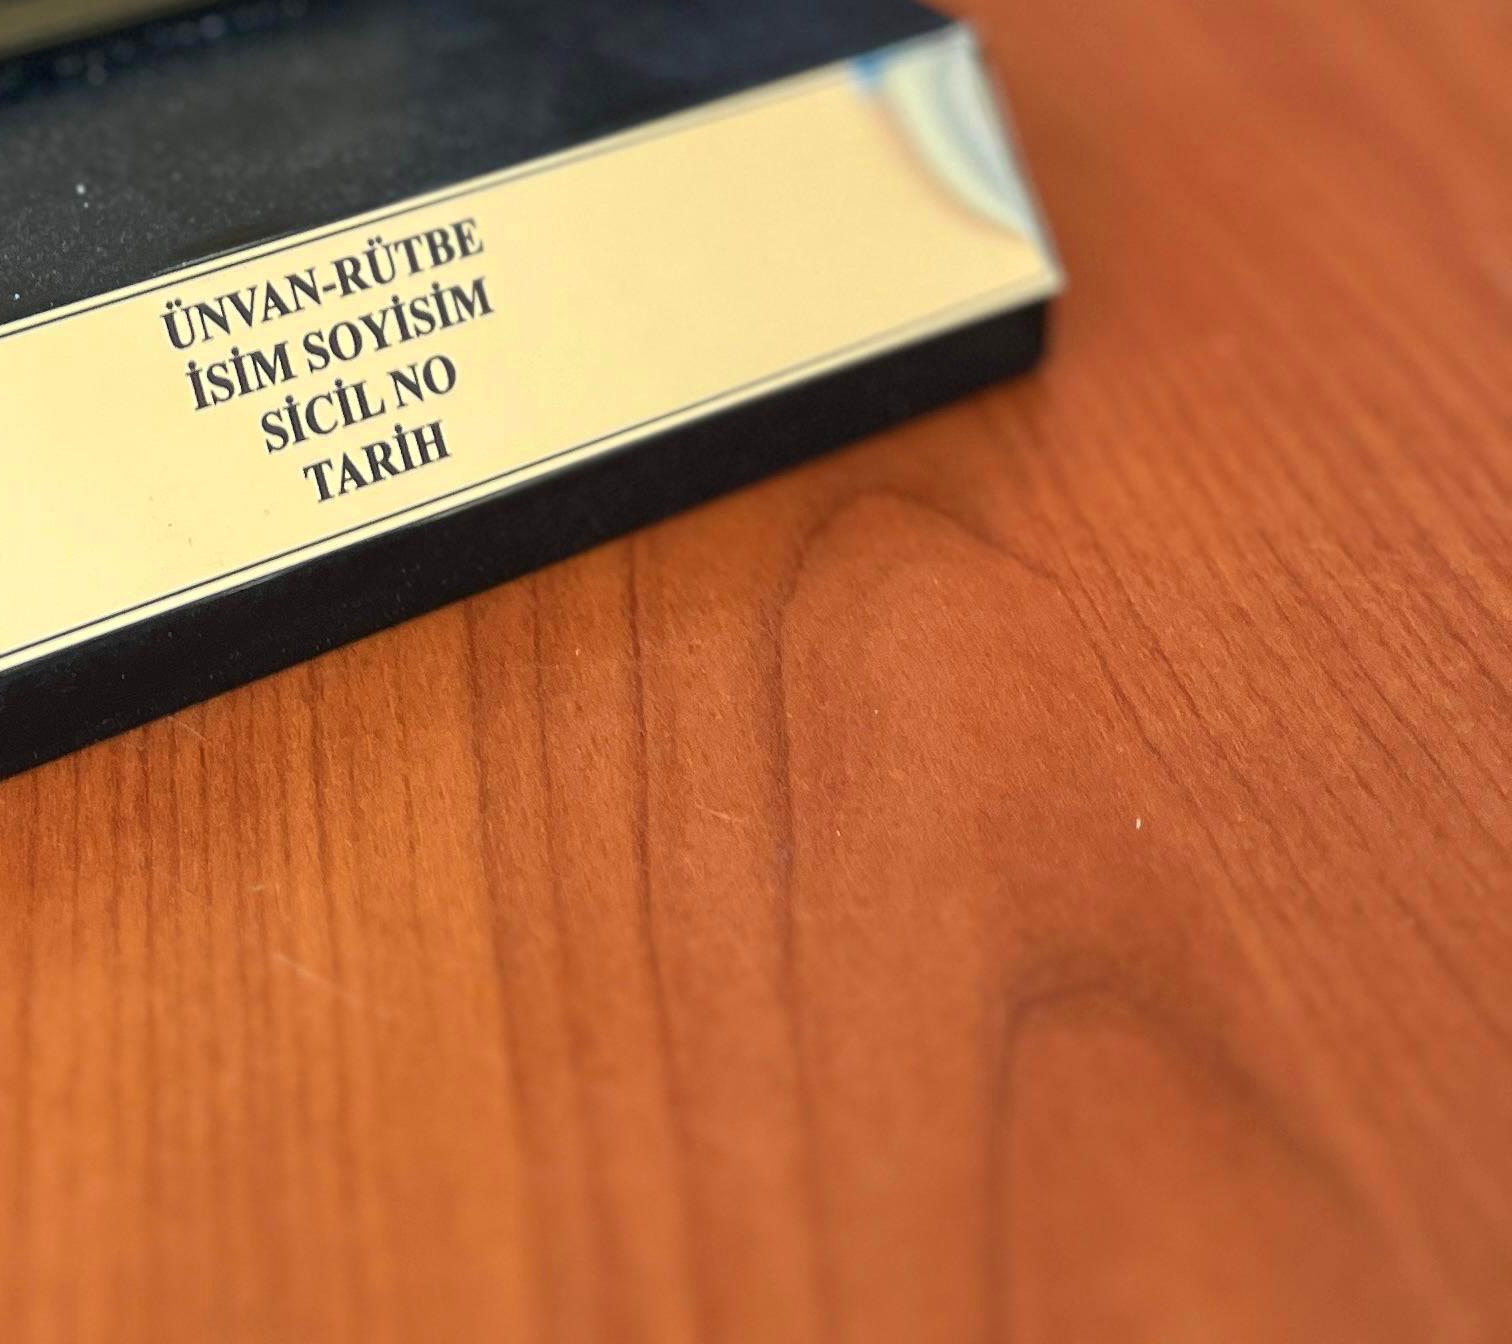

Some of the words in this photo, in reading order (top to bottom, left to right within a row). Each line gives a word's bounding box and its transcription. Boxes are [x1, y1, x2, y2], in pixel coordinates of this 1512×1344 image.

[160, 217, 485, 350] ÜNVAN-RÜTBE
[186, 340, 298, 411] İSİM
[302, 275, 495, 374] SOYİSİM
[261, 377, 387, 453] SİCİL
[387, 354, 458, 409] NO
[303, 419, 451, 503] TARİH
